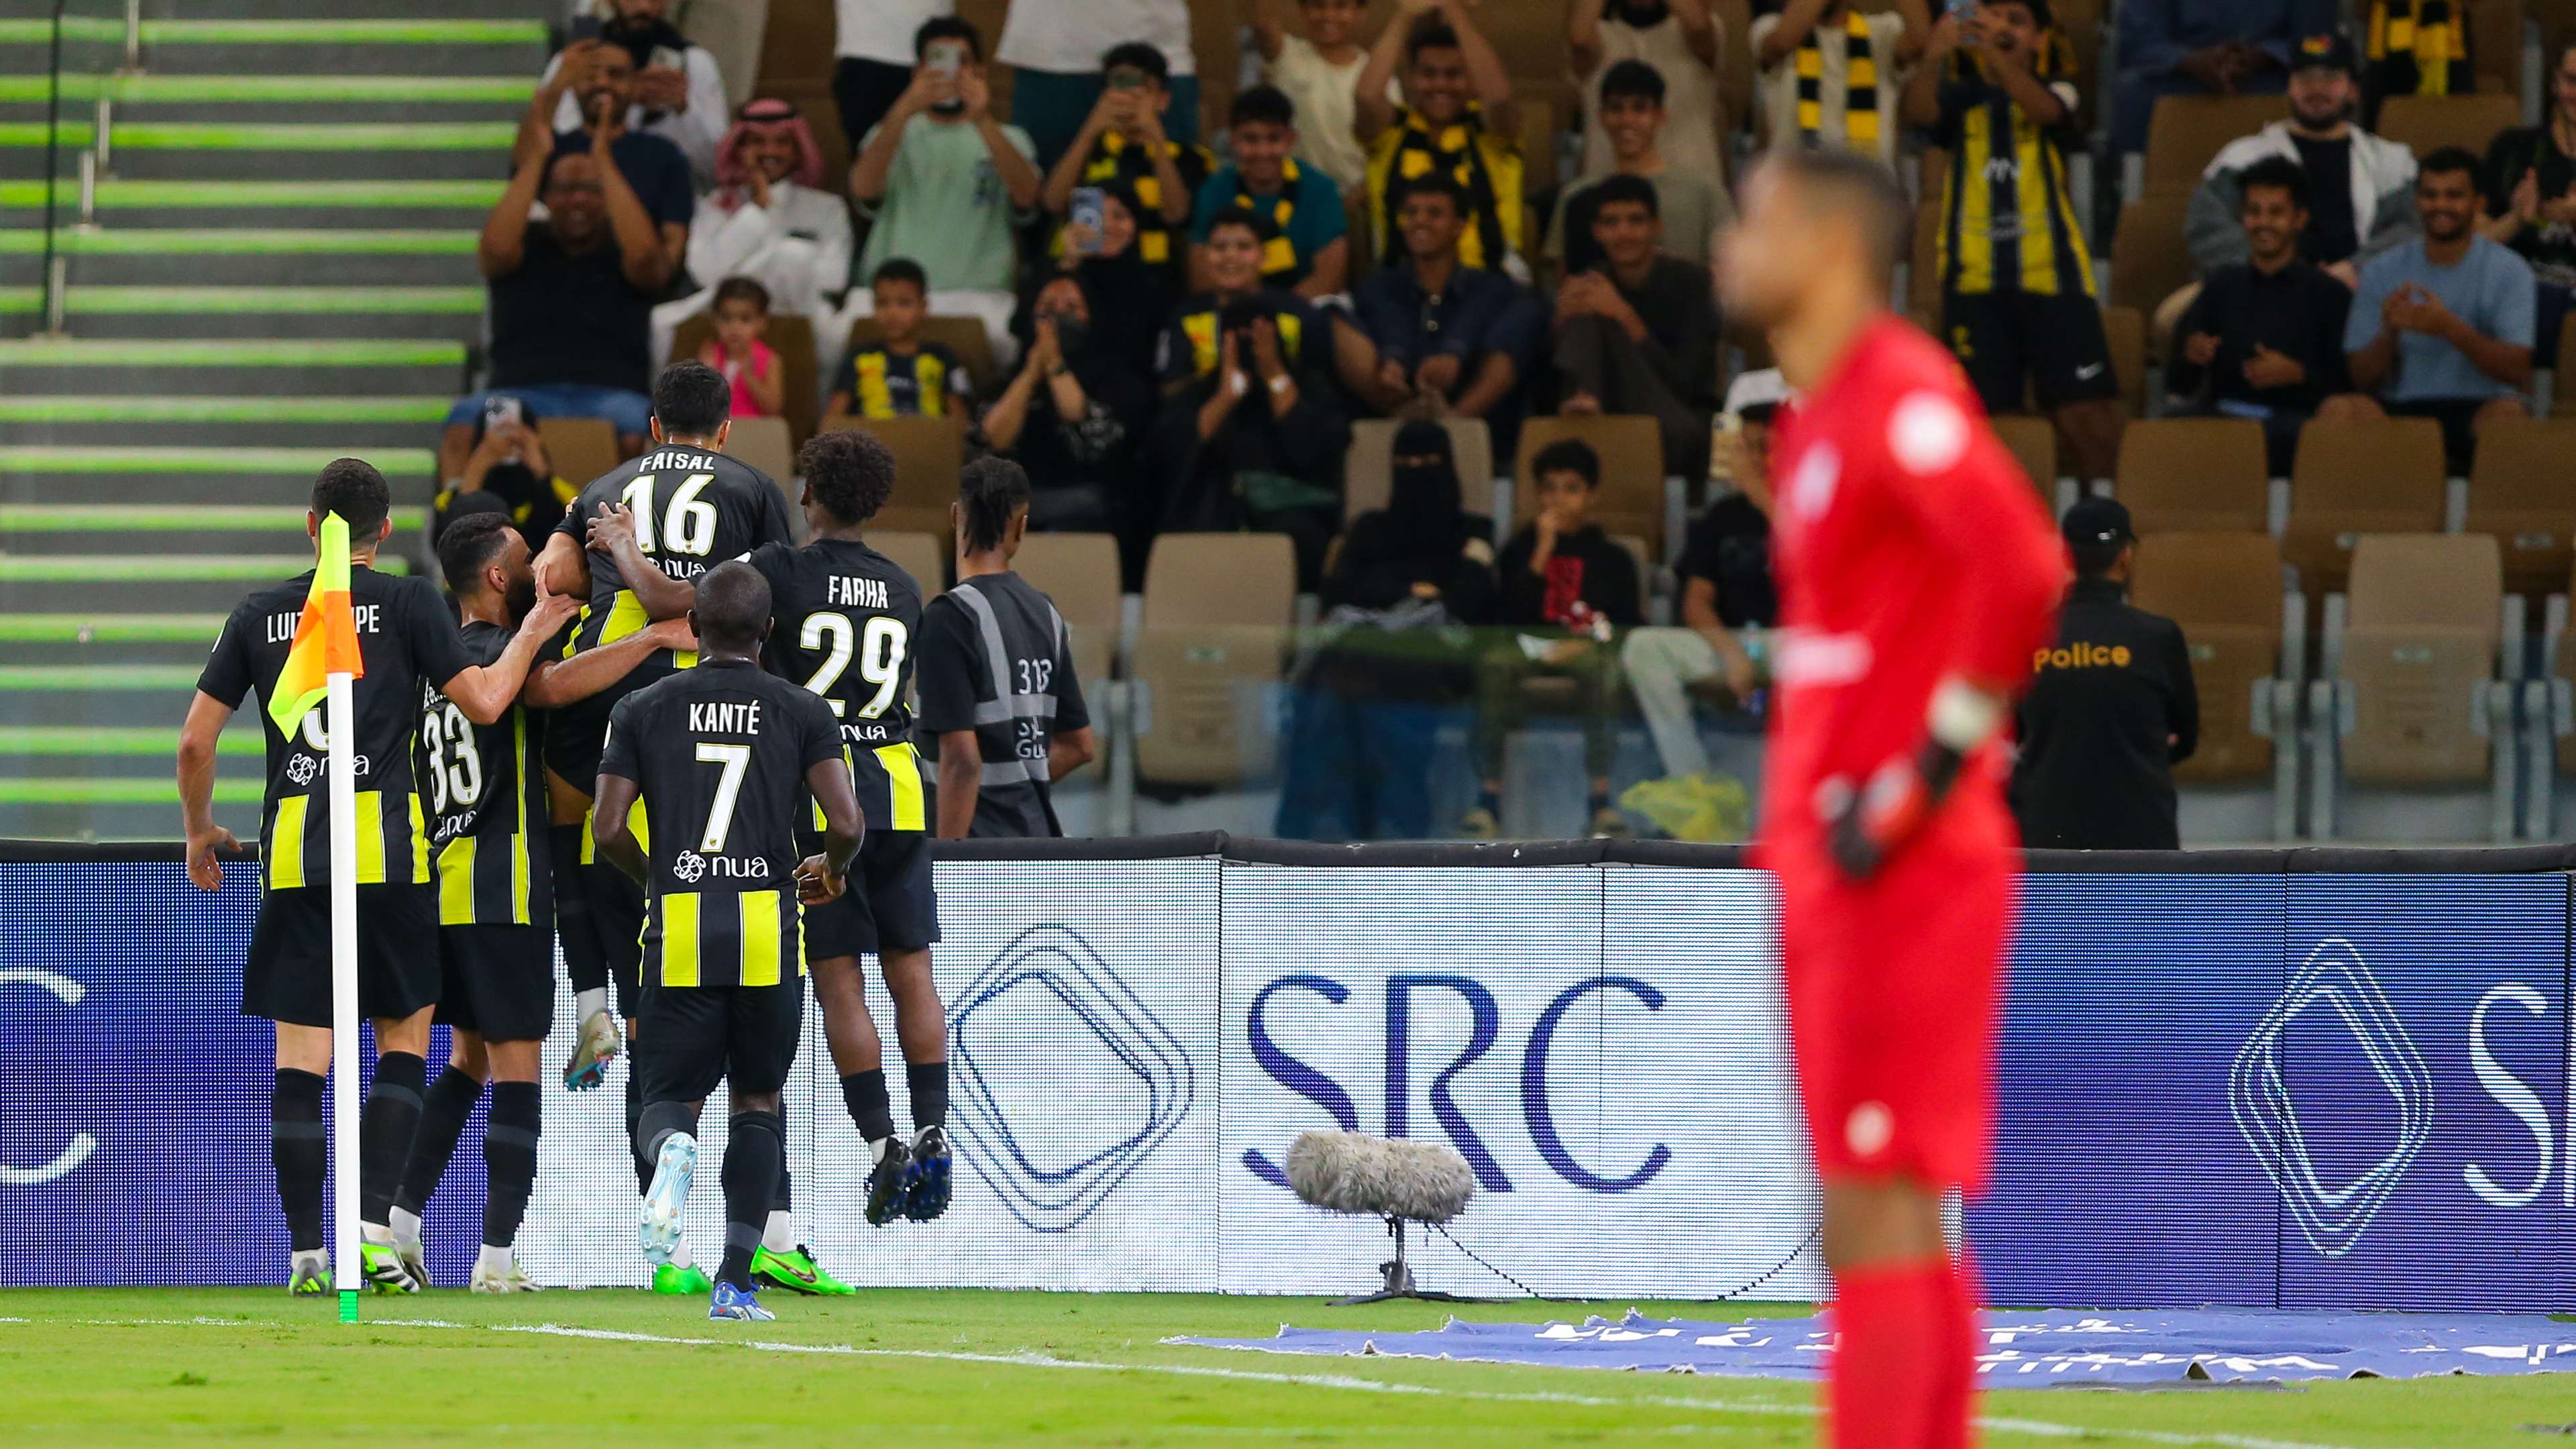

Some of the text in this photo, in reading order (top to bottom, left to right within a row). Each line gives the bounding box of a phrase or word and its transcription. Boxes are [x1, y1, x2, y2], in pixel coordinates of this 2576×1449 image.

[639, 452, 714, 472] FAISAL
[621, 474, 717, 556] 16
[828, 575, 889, 608] FARHA
[800, 612, 908, 719] 29
[2033, 641, 2132, 674] Police
[689, 700, 761, 735] KANTÉ
[839, 724, 888, 741] nua
[423, 702, 482, 816] 33
[696, 743, 751, 853] 7
[712, 856, 769, 877] nua
[1241, 975, 1673, 1194] SRC
